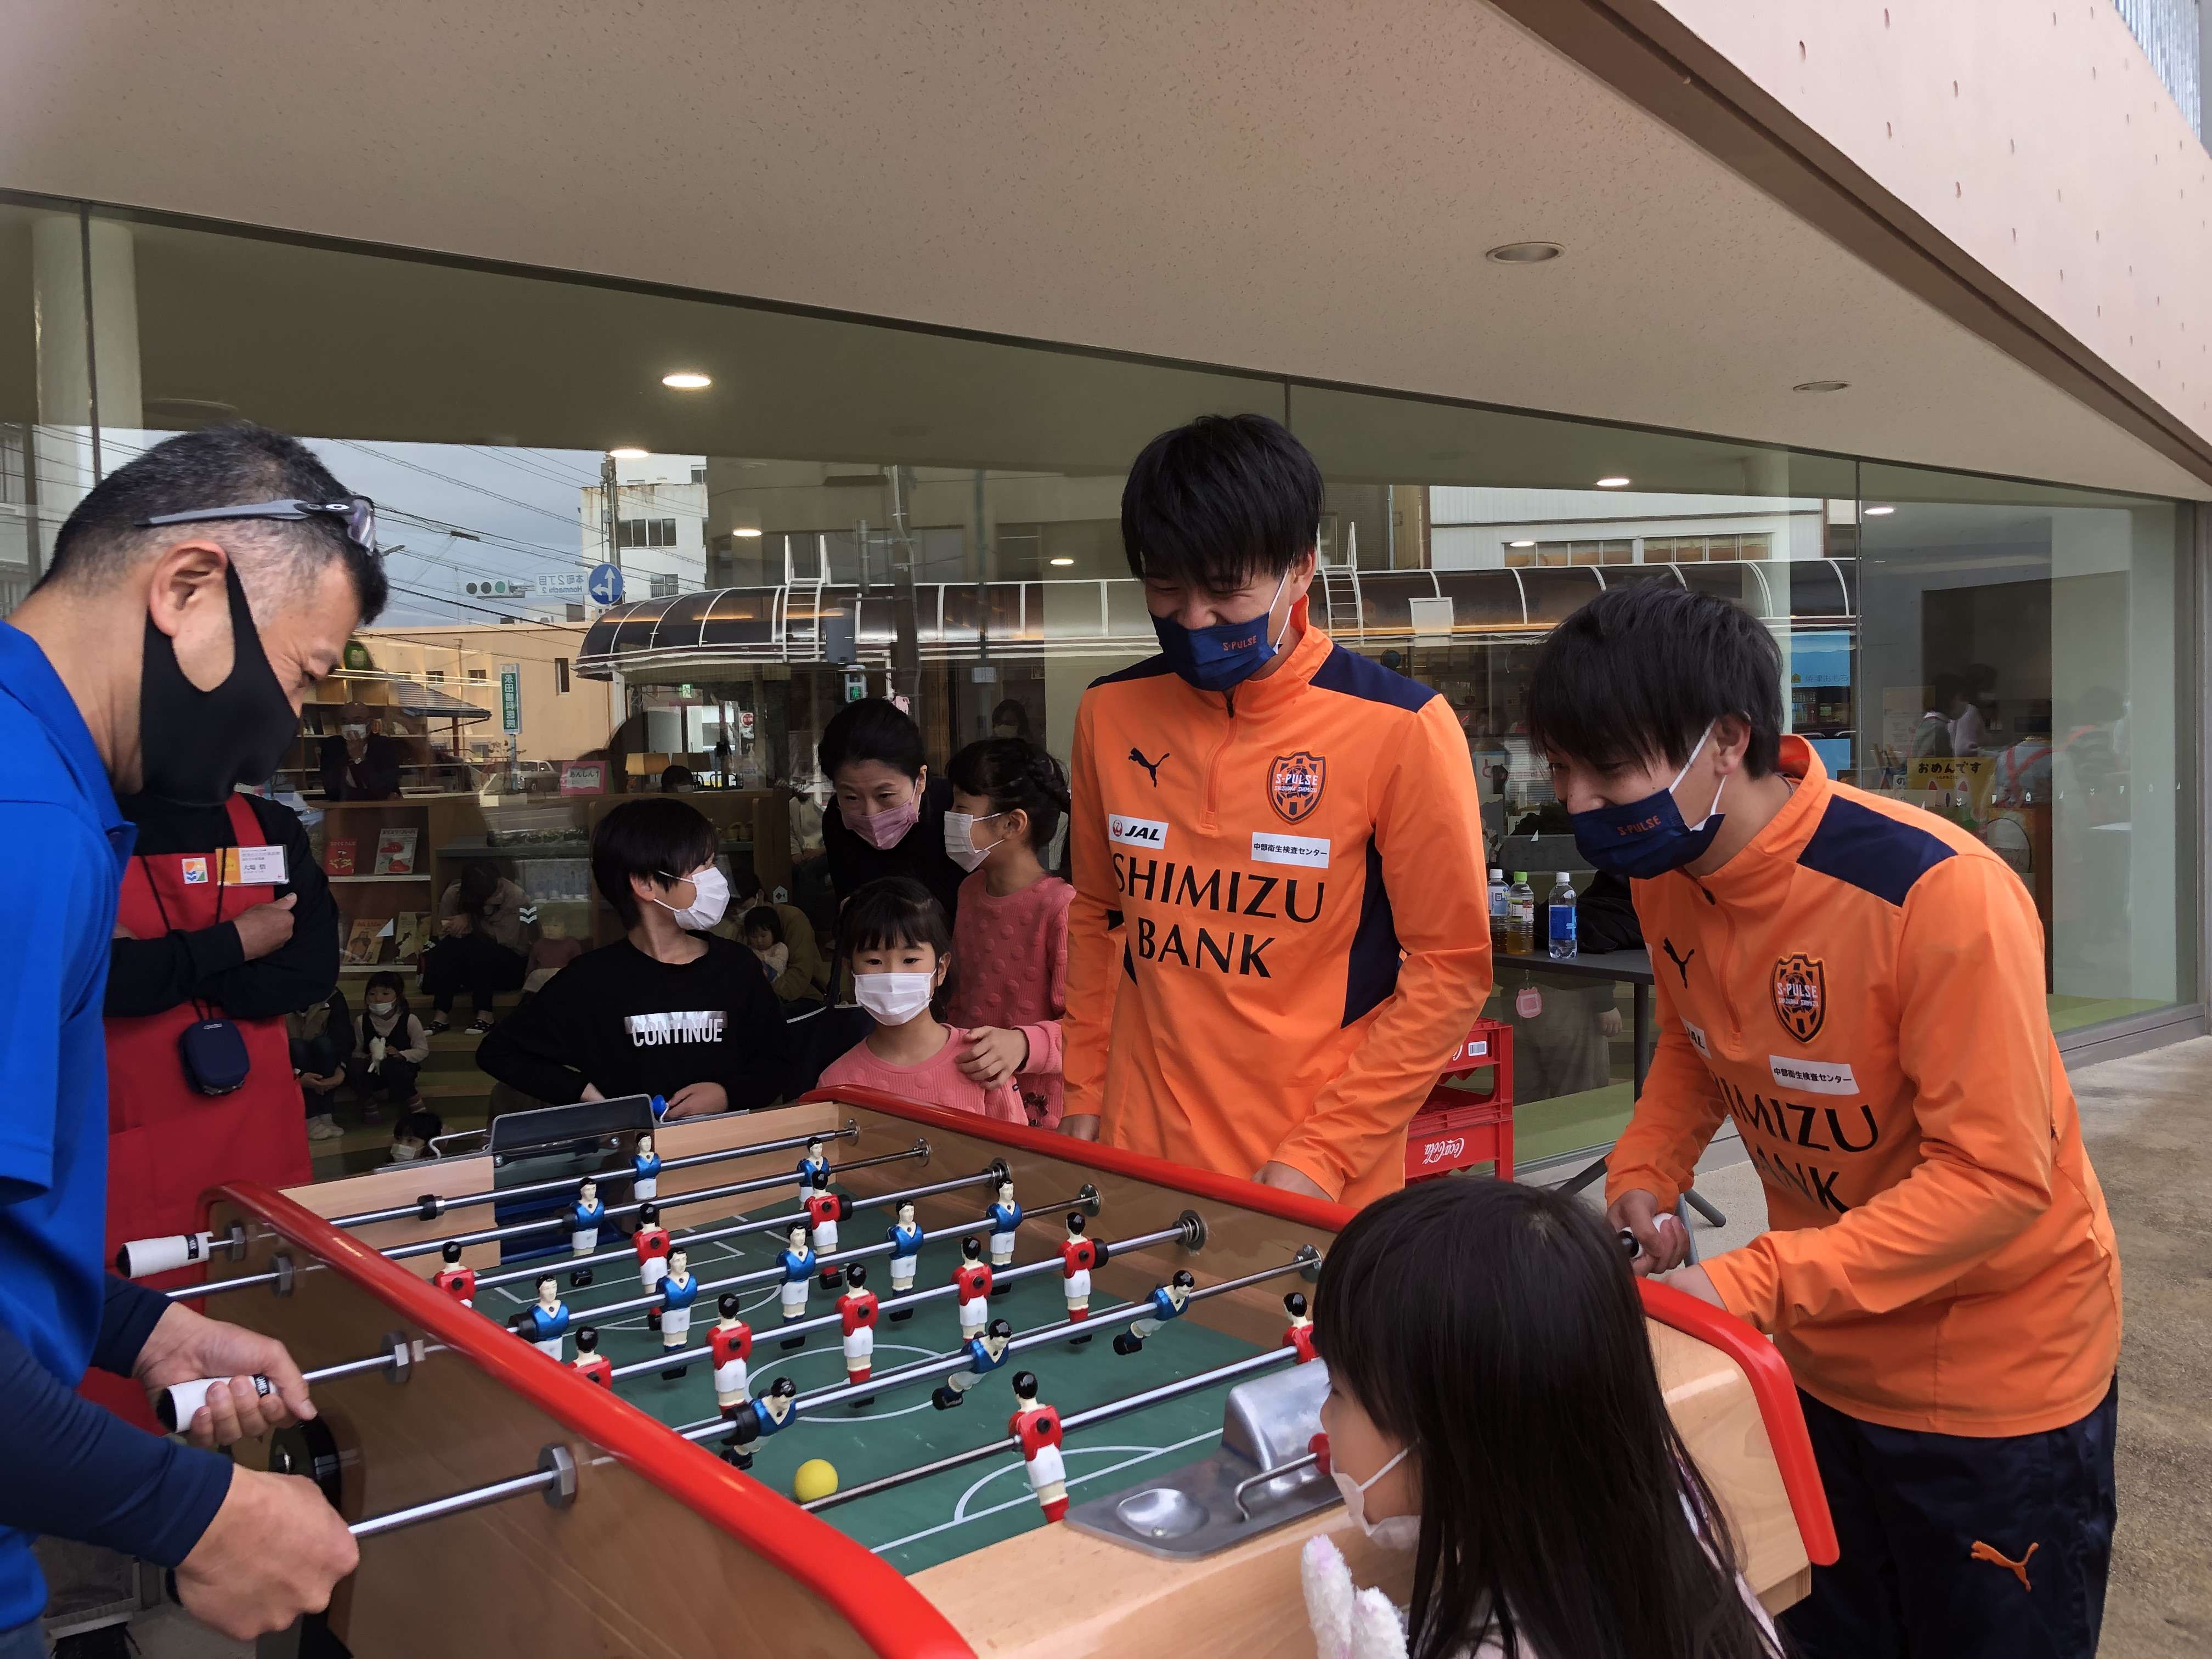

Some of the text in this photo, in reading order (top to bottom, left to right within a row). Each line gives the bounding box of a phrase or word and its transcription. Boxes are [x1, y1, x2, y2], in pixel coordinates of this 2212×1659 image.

[1222, 635, 1257, 651] S-PULSE
[1918, 761, 1982, 774] おめんです
[1275, 774, 1319, 786] S-PULSE
[1124, 825, 1161, 842] JAL
[1616, 815, 1662, 836] S-PULSE
[1253, 842, 1328, 857] 中部衛生検査センター
[1112, 853, 1325, 924] SHIMIZU
[1138, 917, 1276, 978] BANK
[1777, 982, 1818, 998] S-PULSE
[631, 1018, 724, 1047] CONTINUE
[1773, 1067, 1852, 1084] 中部衛生検査センター
[1714, 1076, 1878, 1153] IMIZU
[1750, 1142, 1850, 1214] ANK
